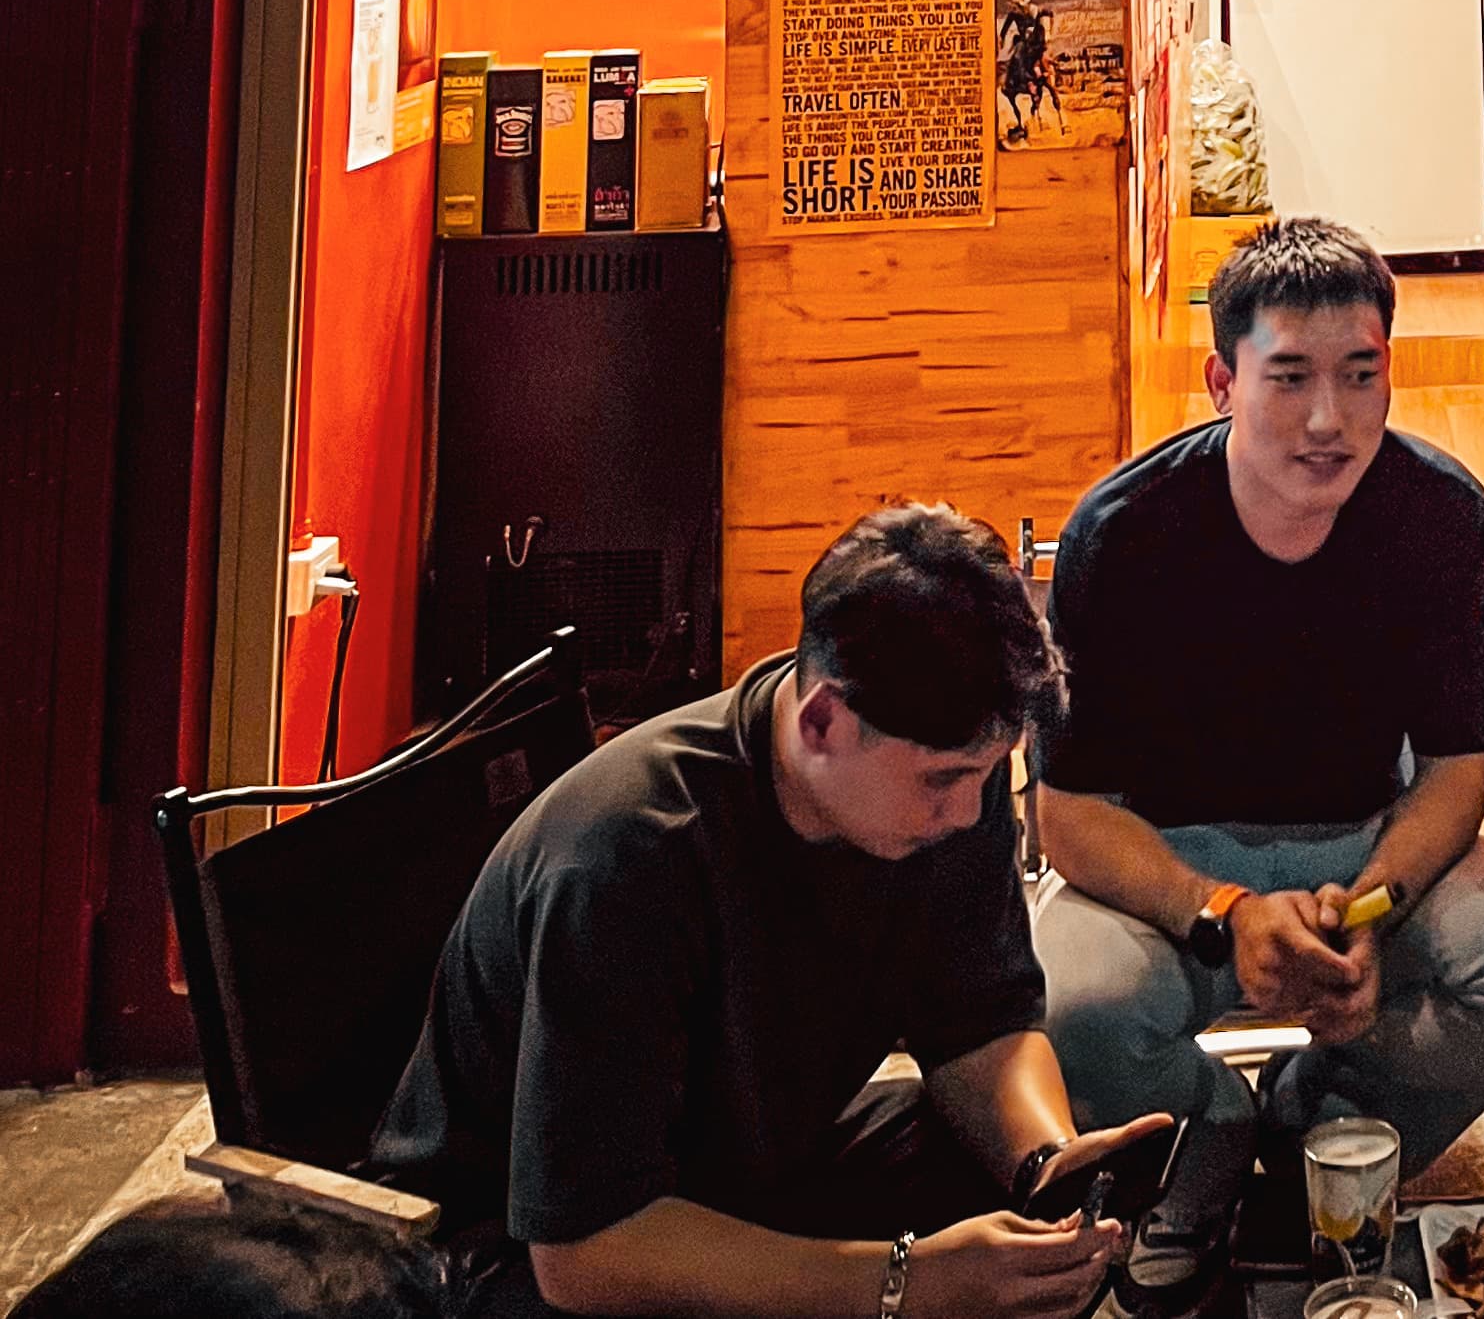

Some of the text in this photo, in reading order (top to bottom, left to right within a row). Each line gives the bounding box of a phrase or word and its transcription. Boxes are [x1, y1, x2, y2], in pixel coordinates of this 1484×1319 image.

[834, 6, 846, 16] BE
[783, 17, 822, 32] START
[826, 16, 865, 30] DOING
[869, 14, 915, 28] THINGS
[919, 13, 945, 26] YOU
[783, 43, 813, 59] LIFE
[818, 42, 833, 57] IS
[934, 36, 957, 52] LAST
[782, 92, 844, 113] TRAVEL
[816, 121, 848, 132] ABOUT
[851, 120, 869, 130] THE
[964, 115, 984, 125] AND
[783, 126, 984, 145] THE THINGS YOU CREATE WITH THEM
[783, 146, 799, 159] SO
[802, 145, 819, 158] GO
[822, 144, 847, 157] OUT
[850, 143, 876, 156] AND
[879, 141, 917, 154] START
[879, 152, 984, 169] LIVE YOUR DREAM
[783, 157, 875, 189] LIFE IS
[879, 166, 983, 192] AND SHARE
[783, 185, 879, 215] SHORT.
[879, 192, 918, 210] YOUR
